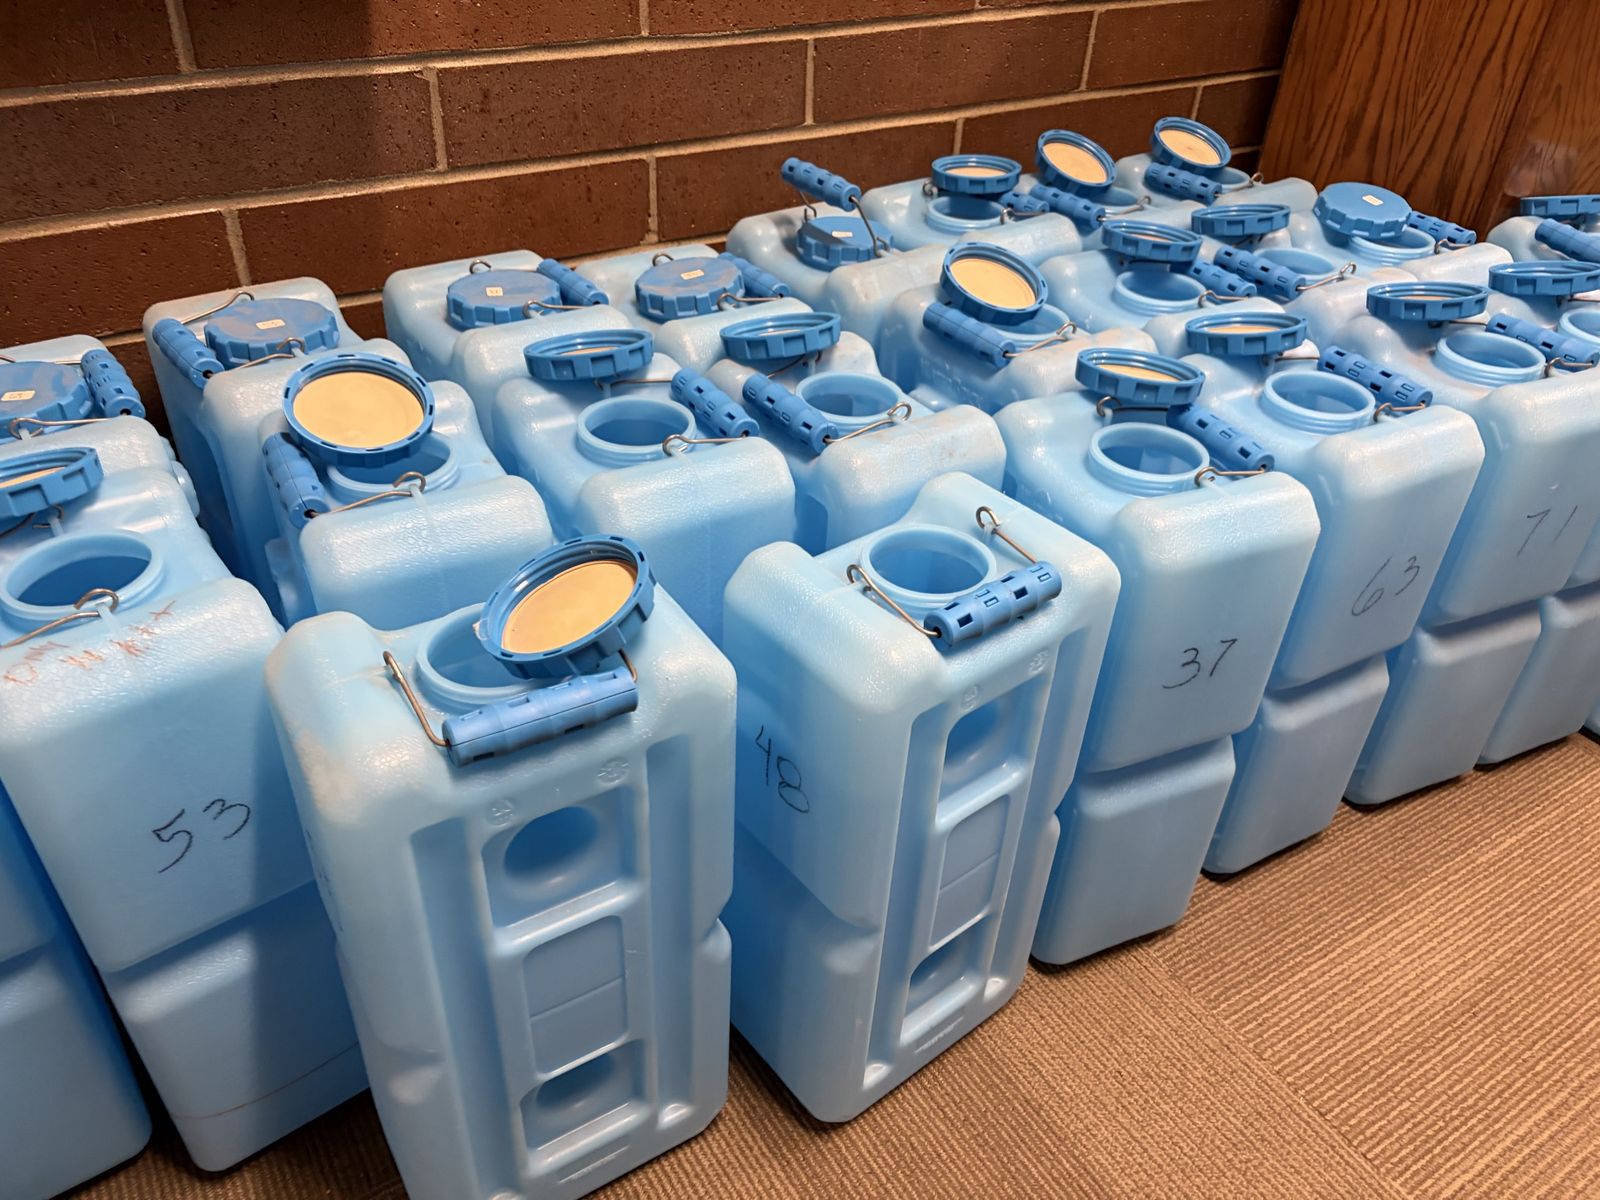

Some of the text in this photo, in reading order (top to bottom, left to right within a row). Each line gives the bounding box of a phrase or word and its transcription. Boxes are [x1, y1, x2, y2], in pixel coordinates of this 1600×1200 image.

[1516, 505, 1578, 558] 71
[1351, 555, 1420, 616] 63
[1162, 638, 1238, 688] 37
[755, 724, 810, 814] 48
[152, 798, 250, 874] 53
